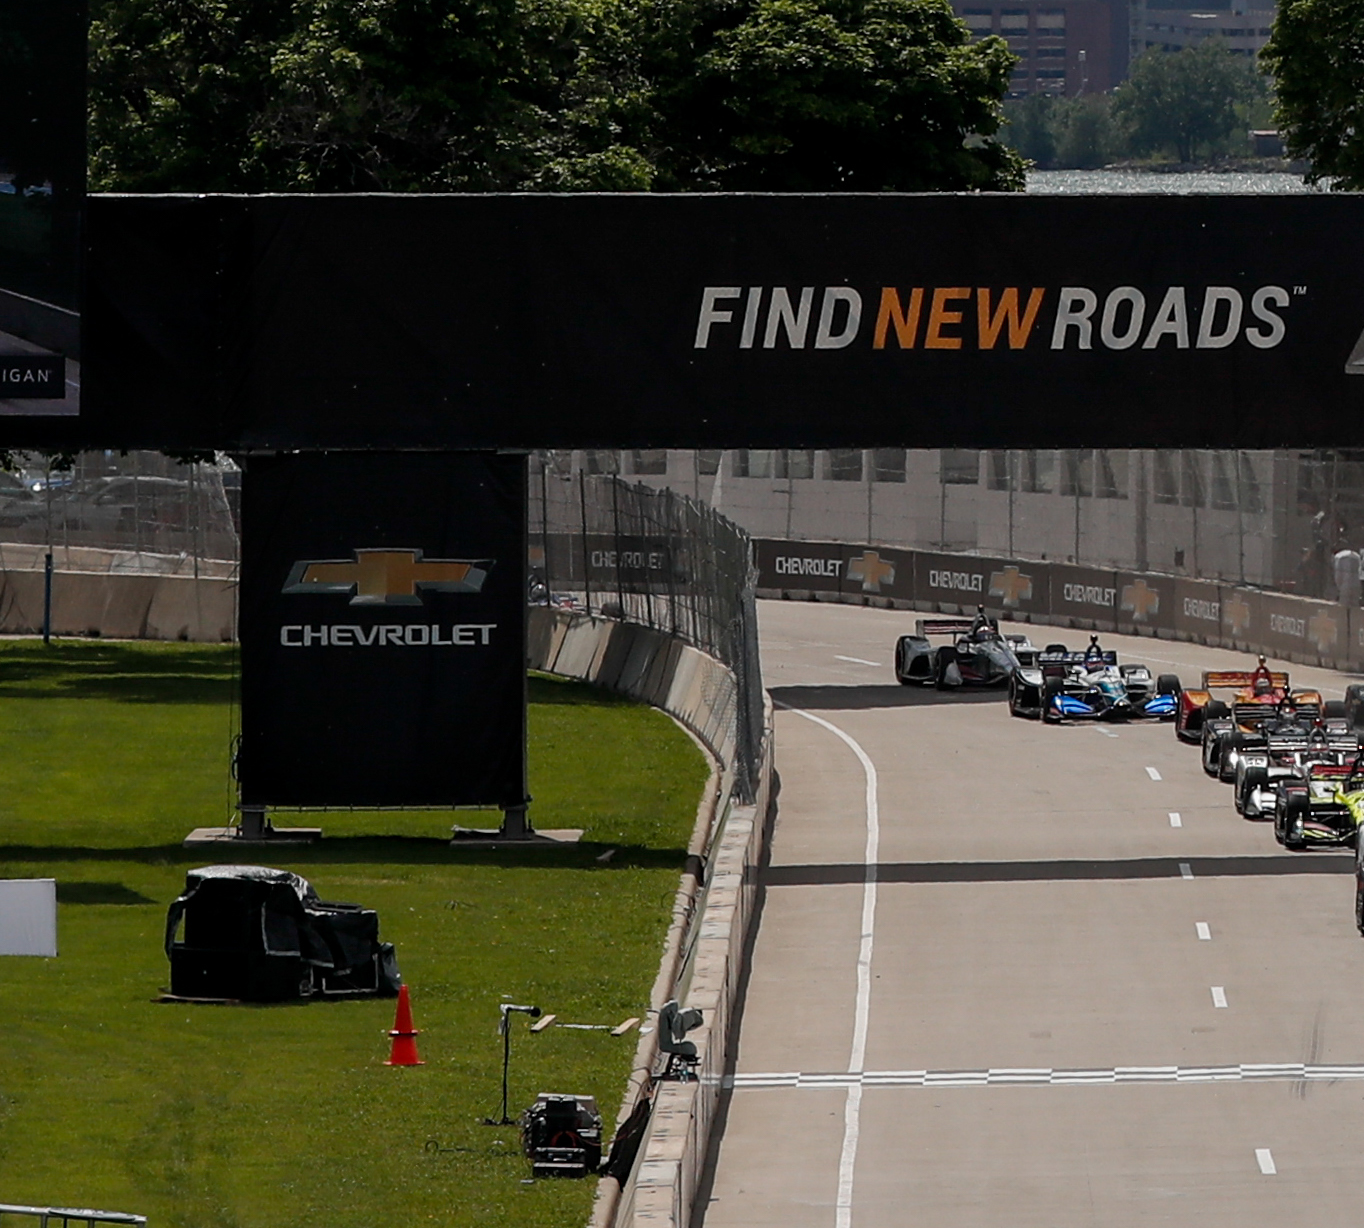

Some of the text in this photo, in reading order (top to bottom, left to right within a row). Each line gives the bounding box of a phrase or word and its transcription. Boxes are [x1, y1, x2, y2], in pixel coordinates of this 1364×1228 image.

[694, 286, 863, 350] FIND
[872, 286, 1045, 350] NEW
[1050, 285, 1292, 350] ROADS
[775, 557, 843, 577] CHEVROLET
[929, 570, 984, 592] CHEVROLET
[1063, 583, 1116, 607] CHEVROLET
[280, 624, 498, 647] CHEVROLET
